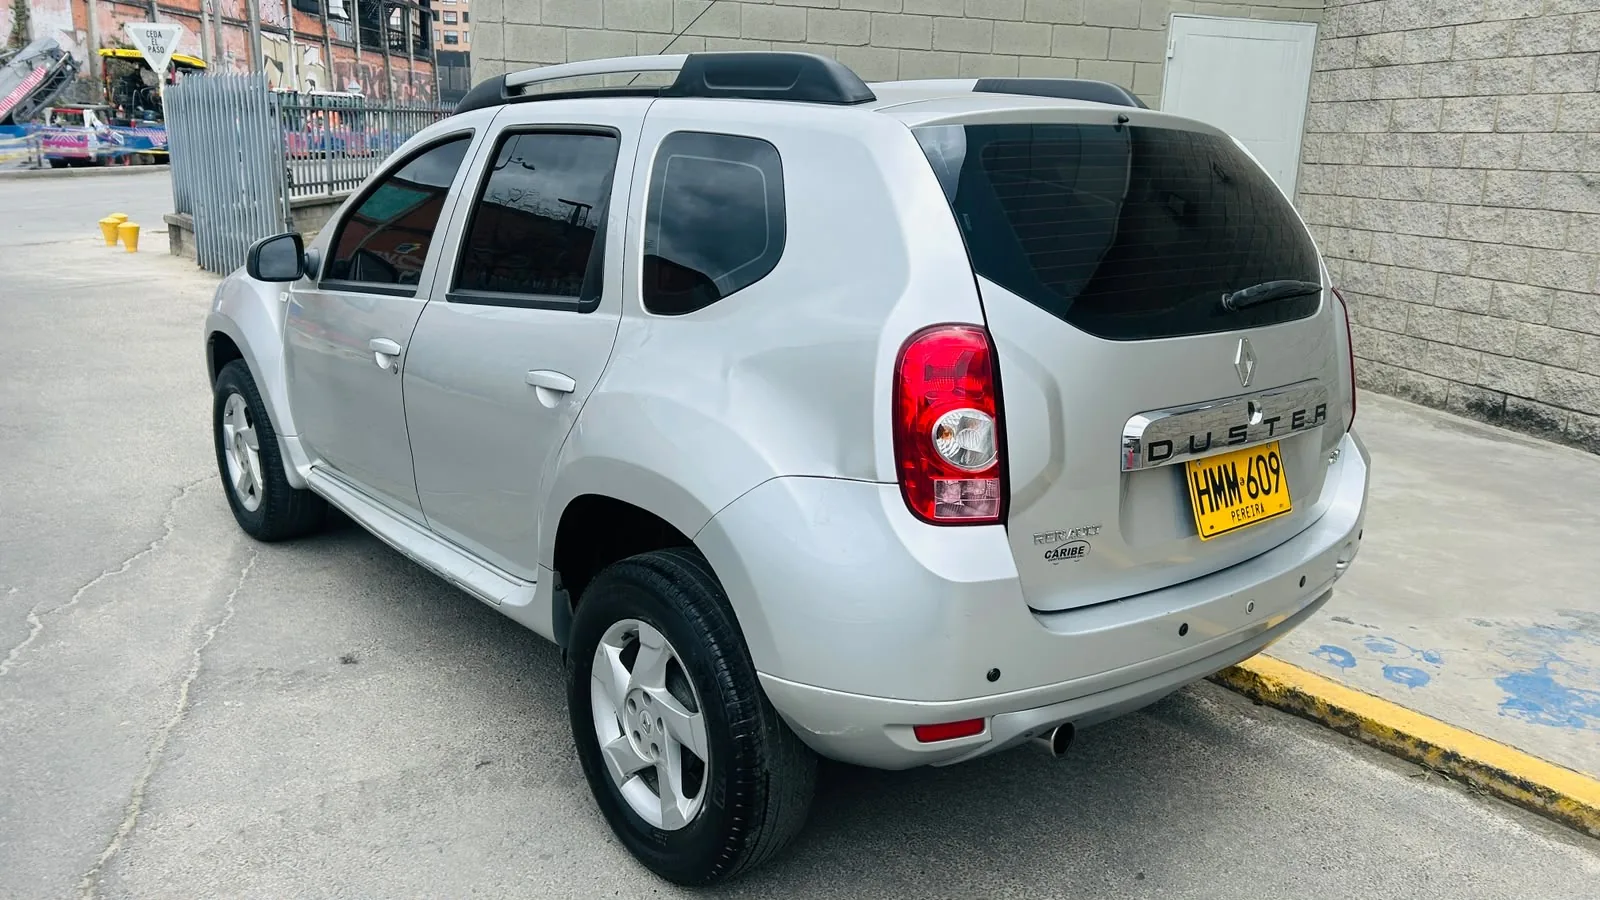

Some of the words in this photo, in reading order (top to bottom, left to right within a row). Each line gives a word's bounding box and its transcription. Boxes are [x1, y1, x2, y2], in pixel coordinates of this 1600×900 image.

[146, 30, 163, 39] CEDA
[151, 38, 159, 46] EL
[147, 46, 165, 54] PASO
[1148, 403, 1327, 462] DUSTER
[1193, 461, 1243, 516] HMM
[1246, 451, 1280, 500] 609
[1231, 502, 1265, 523] PEREIRA
[1044, 545, 1086, 559] CARIBE
